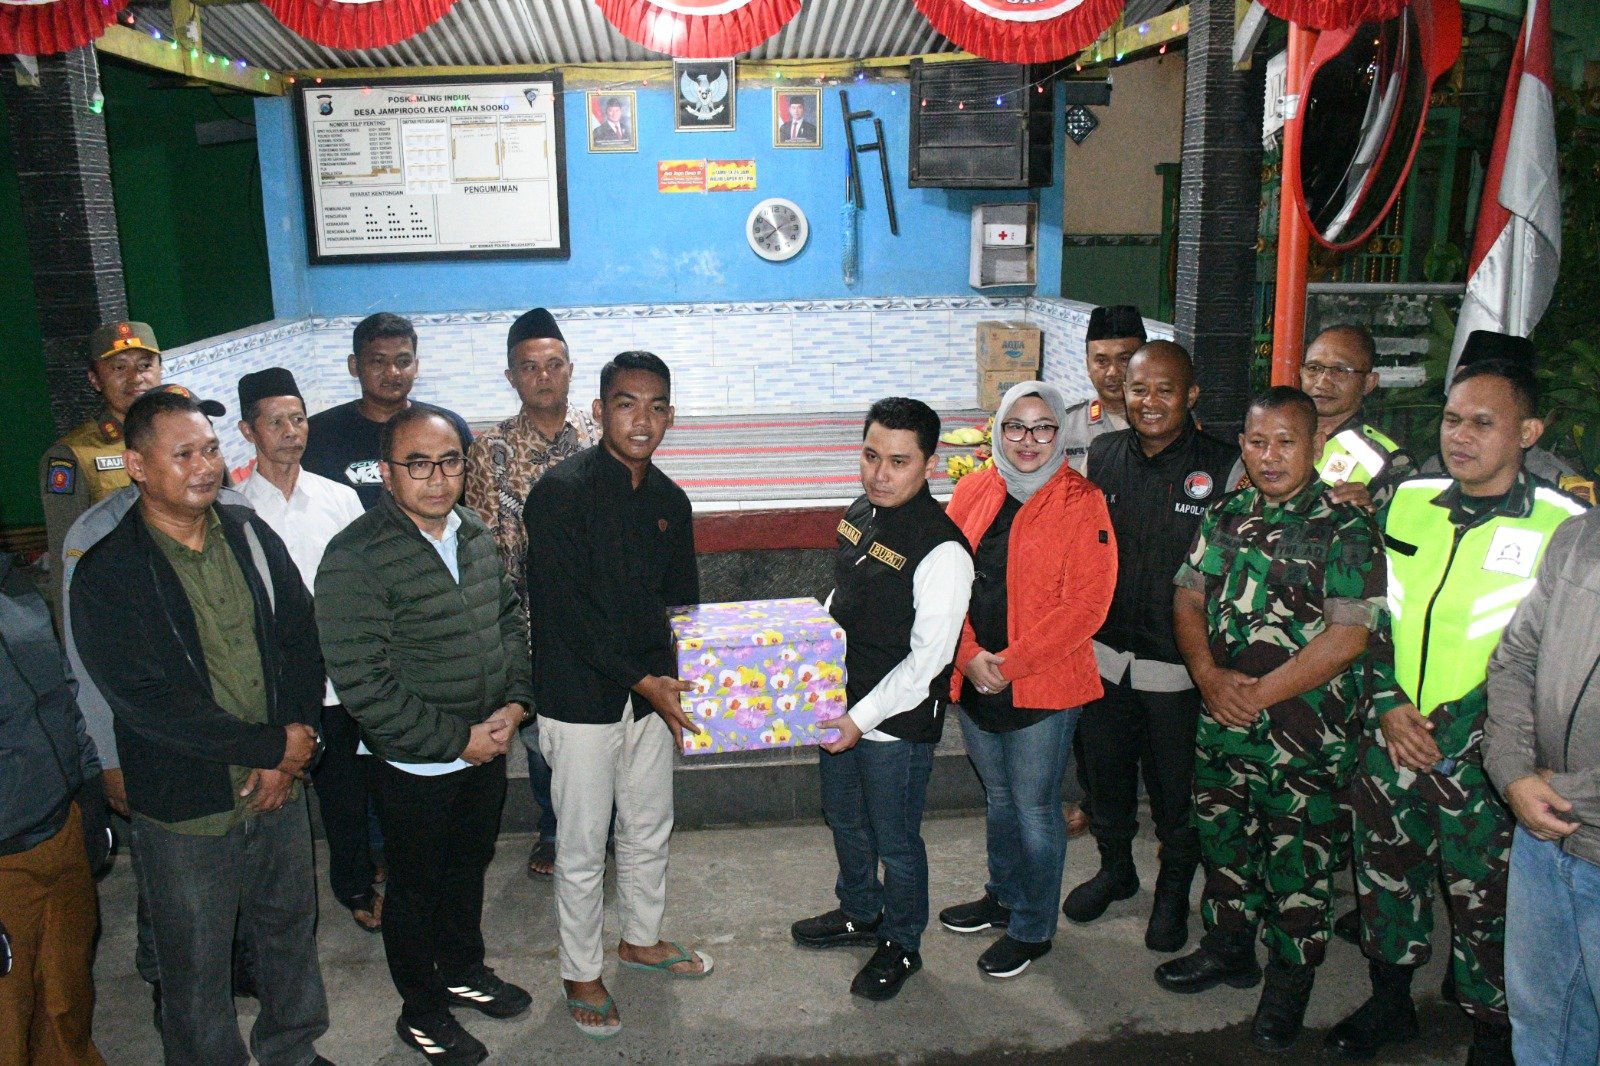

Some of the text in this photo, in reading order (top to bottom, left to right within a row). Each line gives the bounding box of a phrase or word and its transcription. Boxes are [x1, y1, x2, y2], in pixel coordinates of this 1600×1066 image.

[354, 104, 510, 116] DESA JAMPIROGO KECAMATAN SOOKO
[464, 185, 518, 194] PENGUMUMAN
[1002, 341, 1025, 350] AQUA
[838, 522, 860, 541] BARRA
[872, 544, 903, 567] BUPATI
